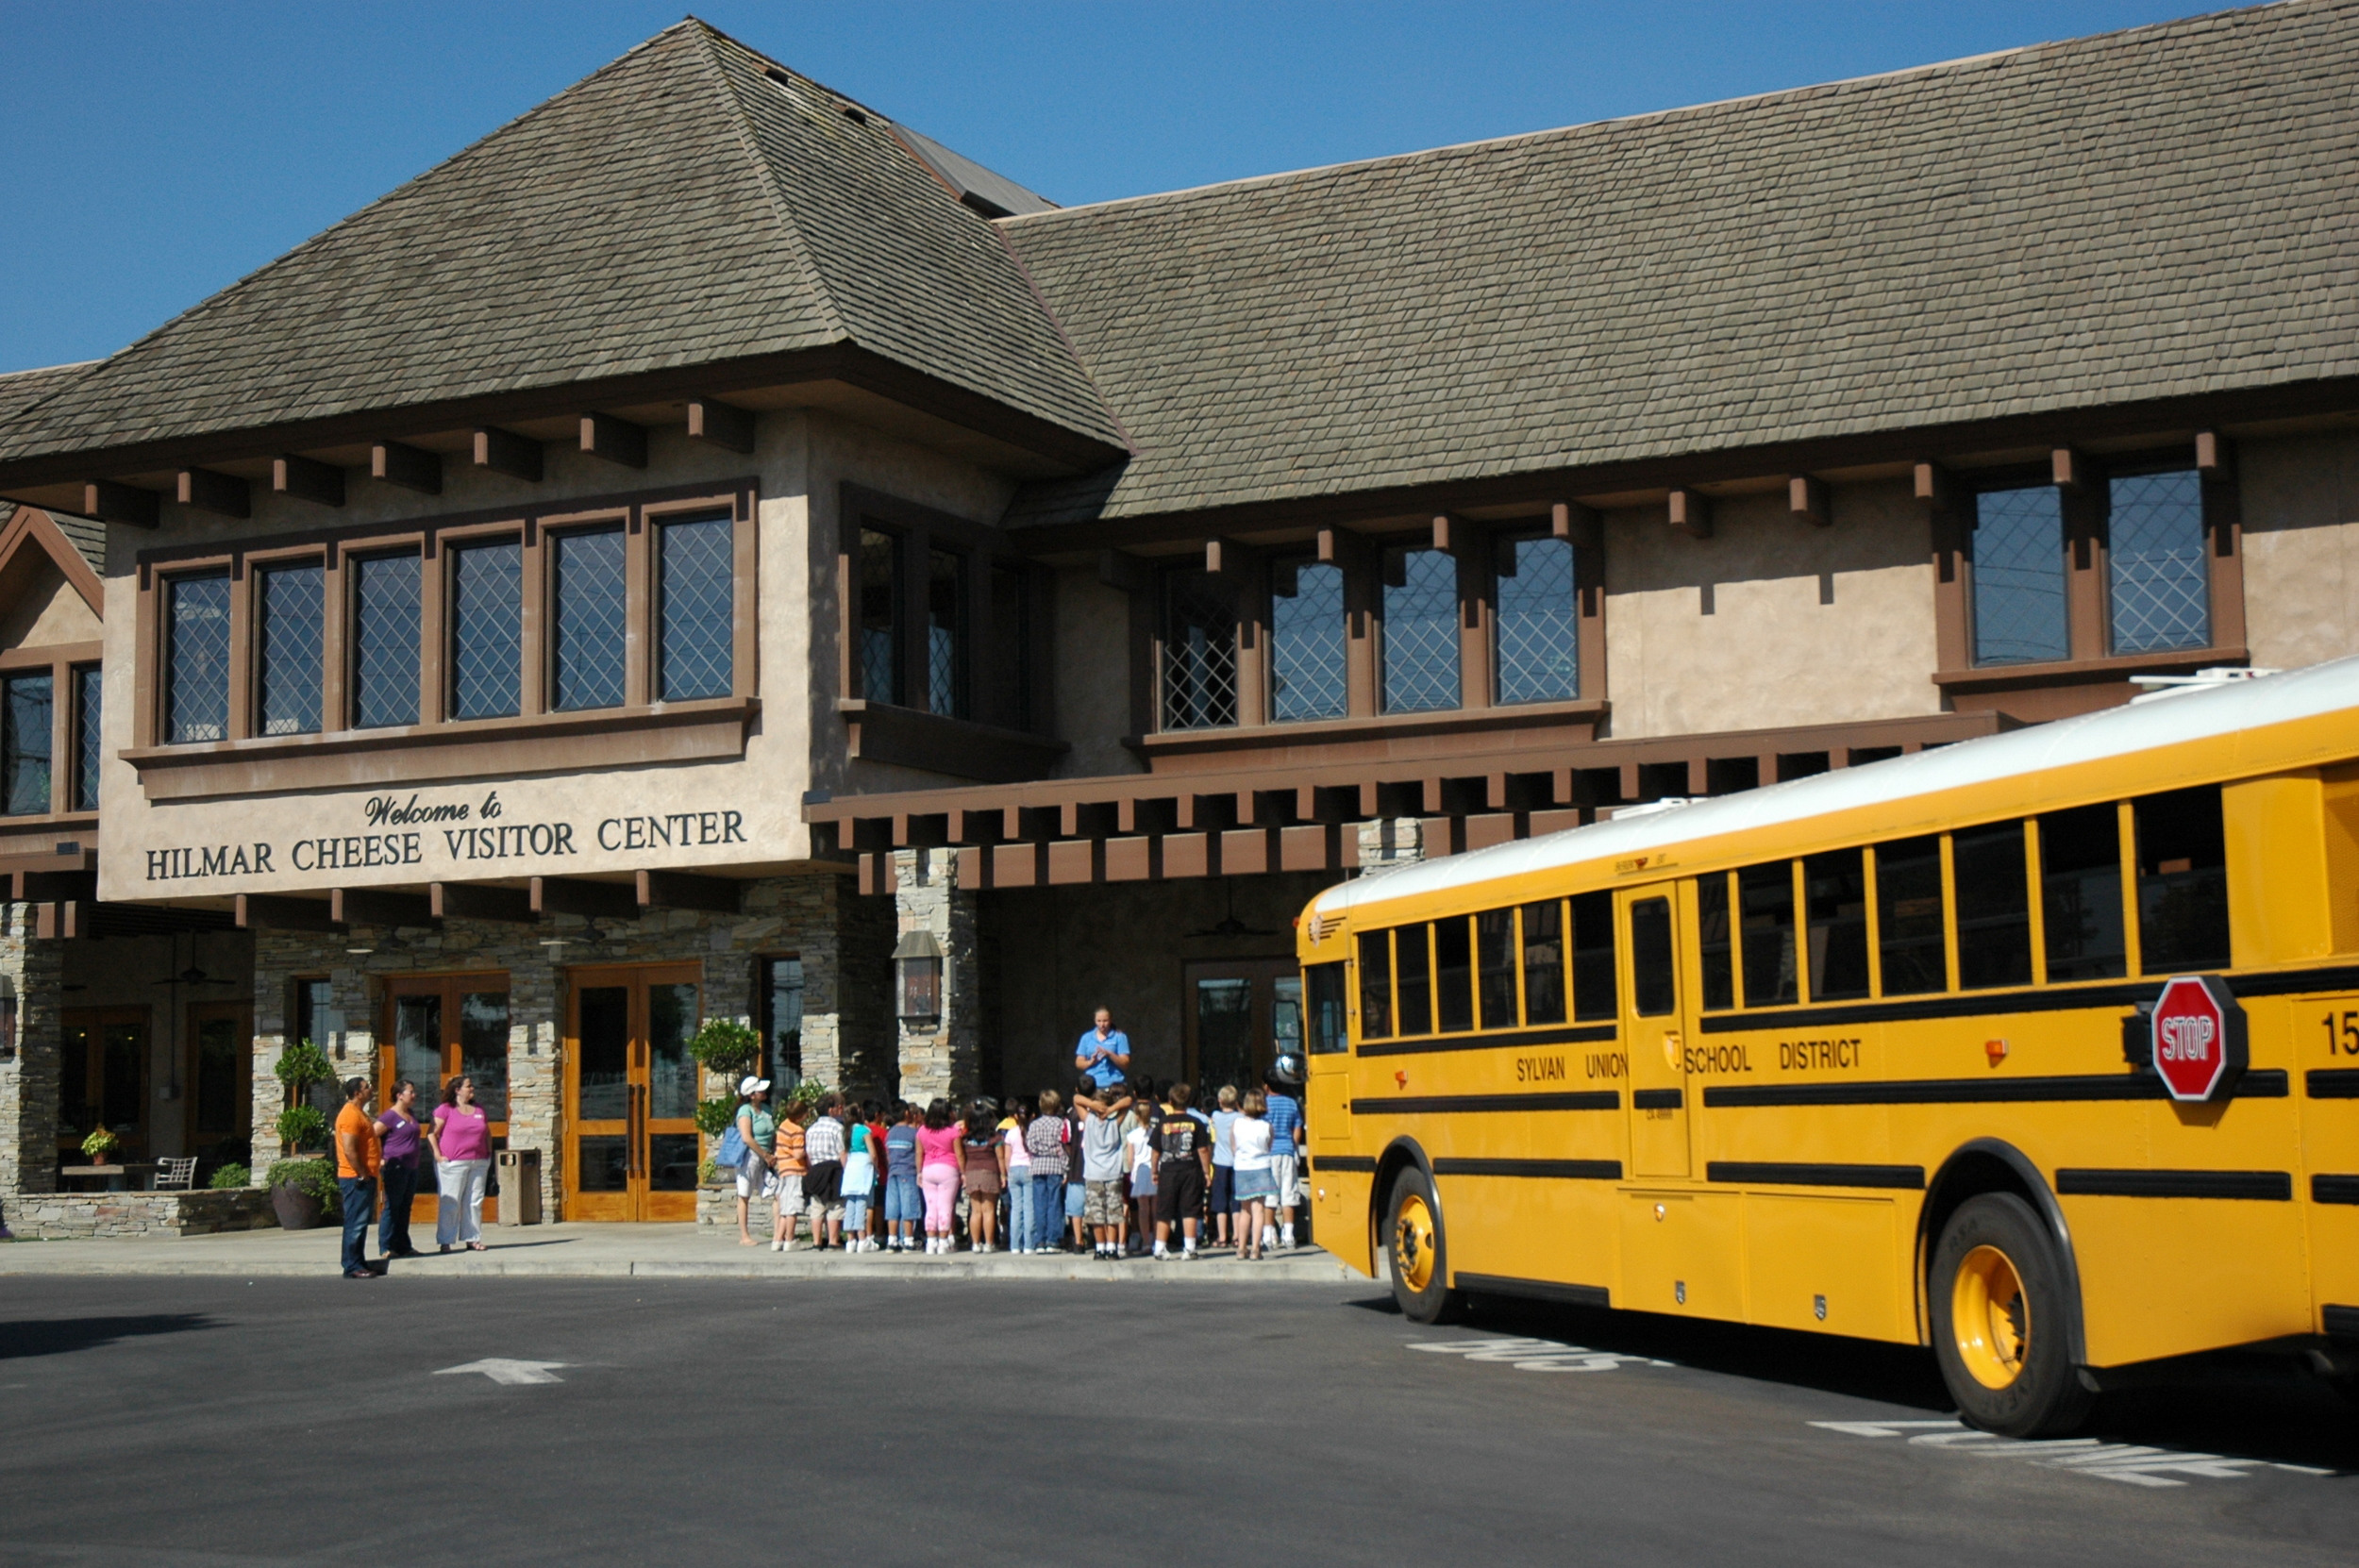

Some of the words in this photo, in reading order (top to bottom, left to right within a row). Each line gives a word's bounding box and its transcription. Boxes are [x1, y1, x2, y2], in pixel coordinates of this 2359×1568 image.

[364, 793, 469, 827] Welcome
[479, 791, 502, 819] to
[145, 841, 276, 880] HILMAR
[292, 832, 423, 871] CHEESE
[443, 824, 577, 861] VISITOR
[597, 810, 747, 851] CENTER
[2162, 1015, 2214, 1060] STOP
[1517, 1057, 1564, 1082] SYLVAN
[1586, 1053, 1629, 1078] UNION
[1685, 1045, 1752, 1074] SCHOOL
[1780, 1040, 1861, 1070] DISTRICT
[1405, 1338, 1677, 1372] BUS
